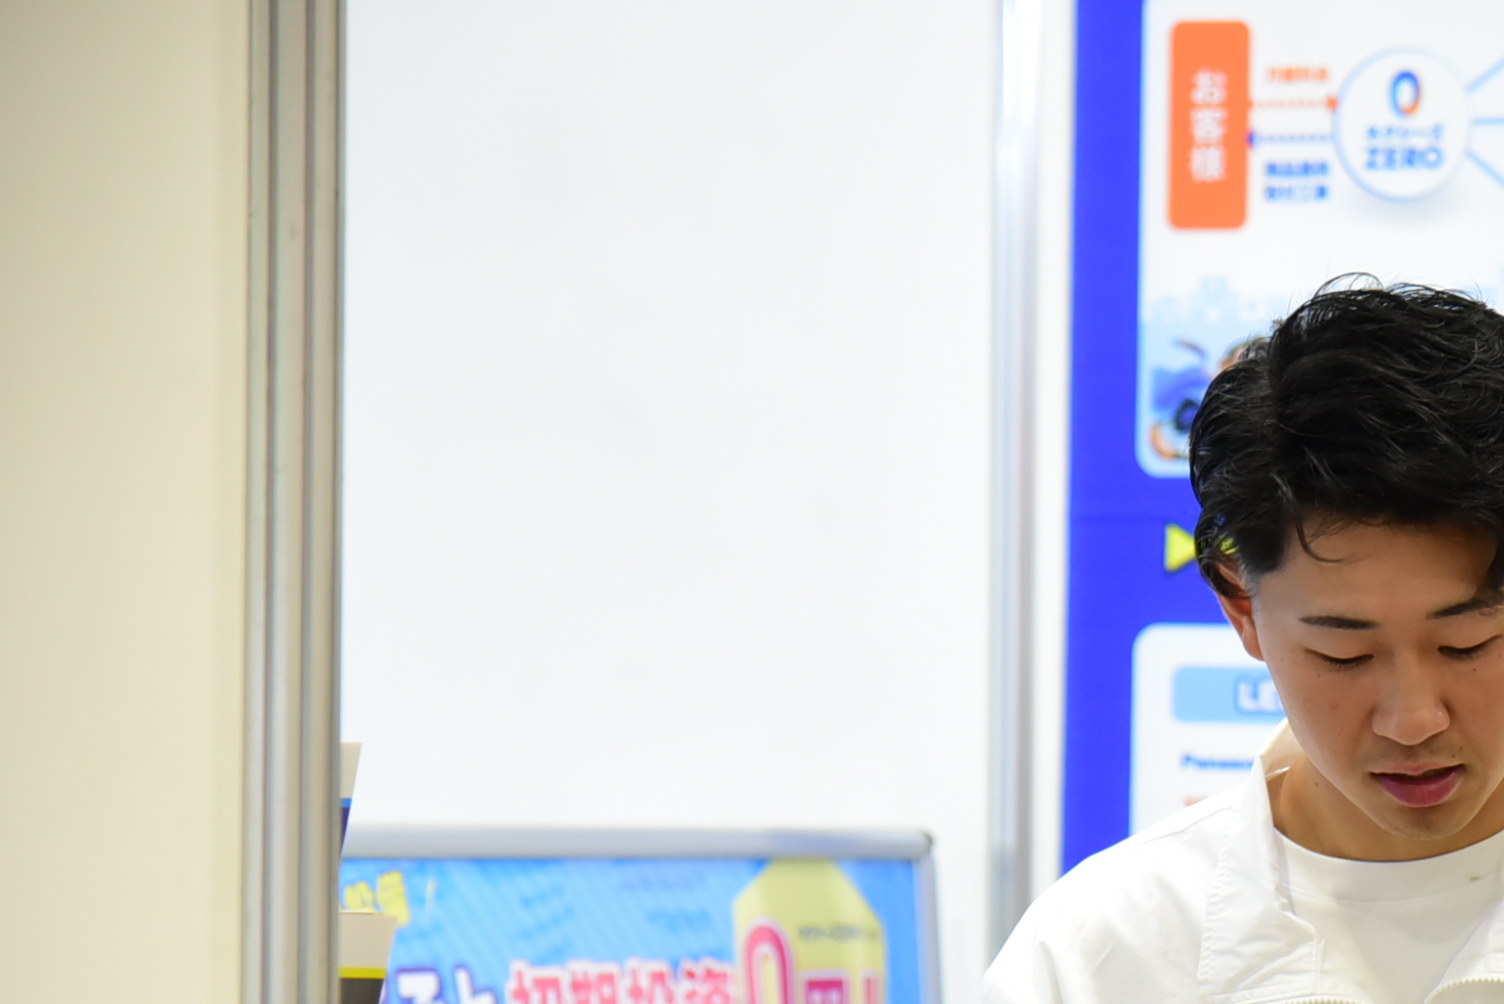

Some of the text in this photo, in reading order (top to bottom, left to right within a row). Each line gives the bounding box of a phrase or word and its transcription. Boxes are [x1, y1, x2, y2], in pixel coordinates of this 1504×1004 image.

[1189, 67, 1229, 183] お客様
[1365, 146, 1444, 171] ZERO
